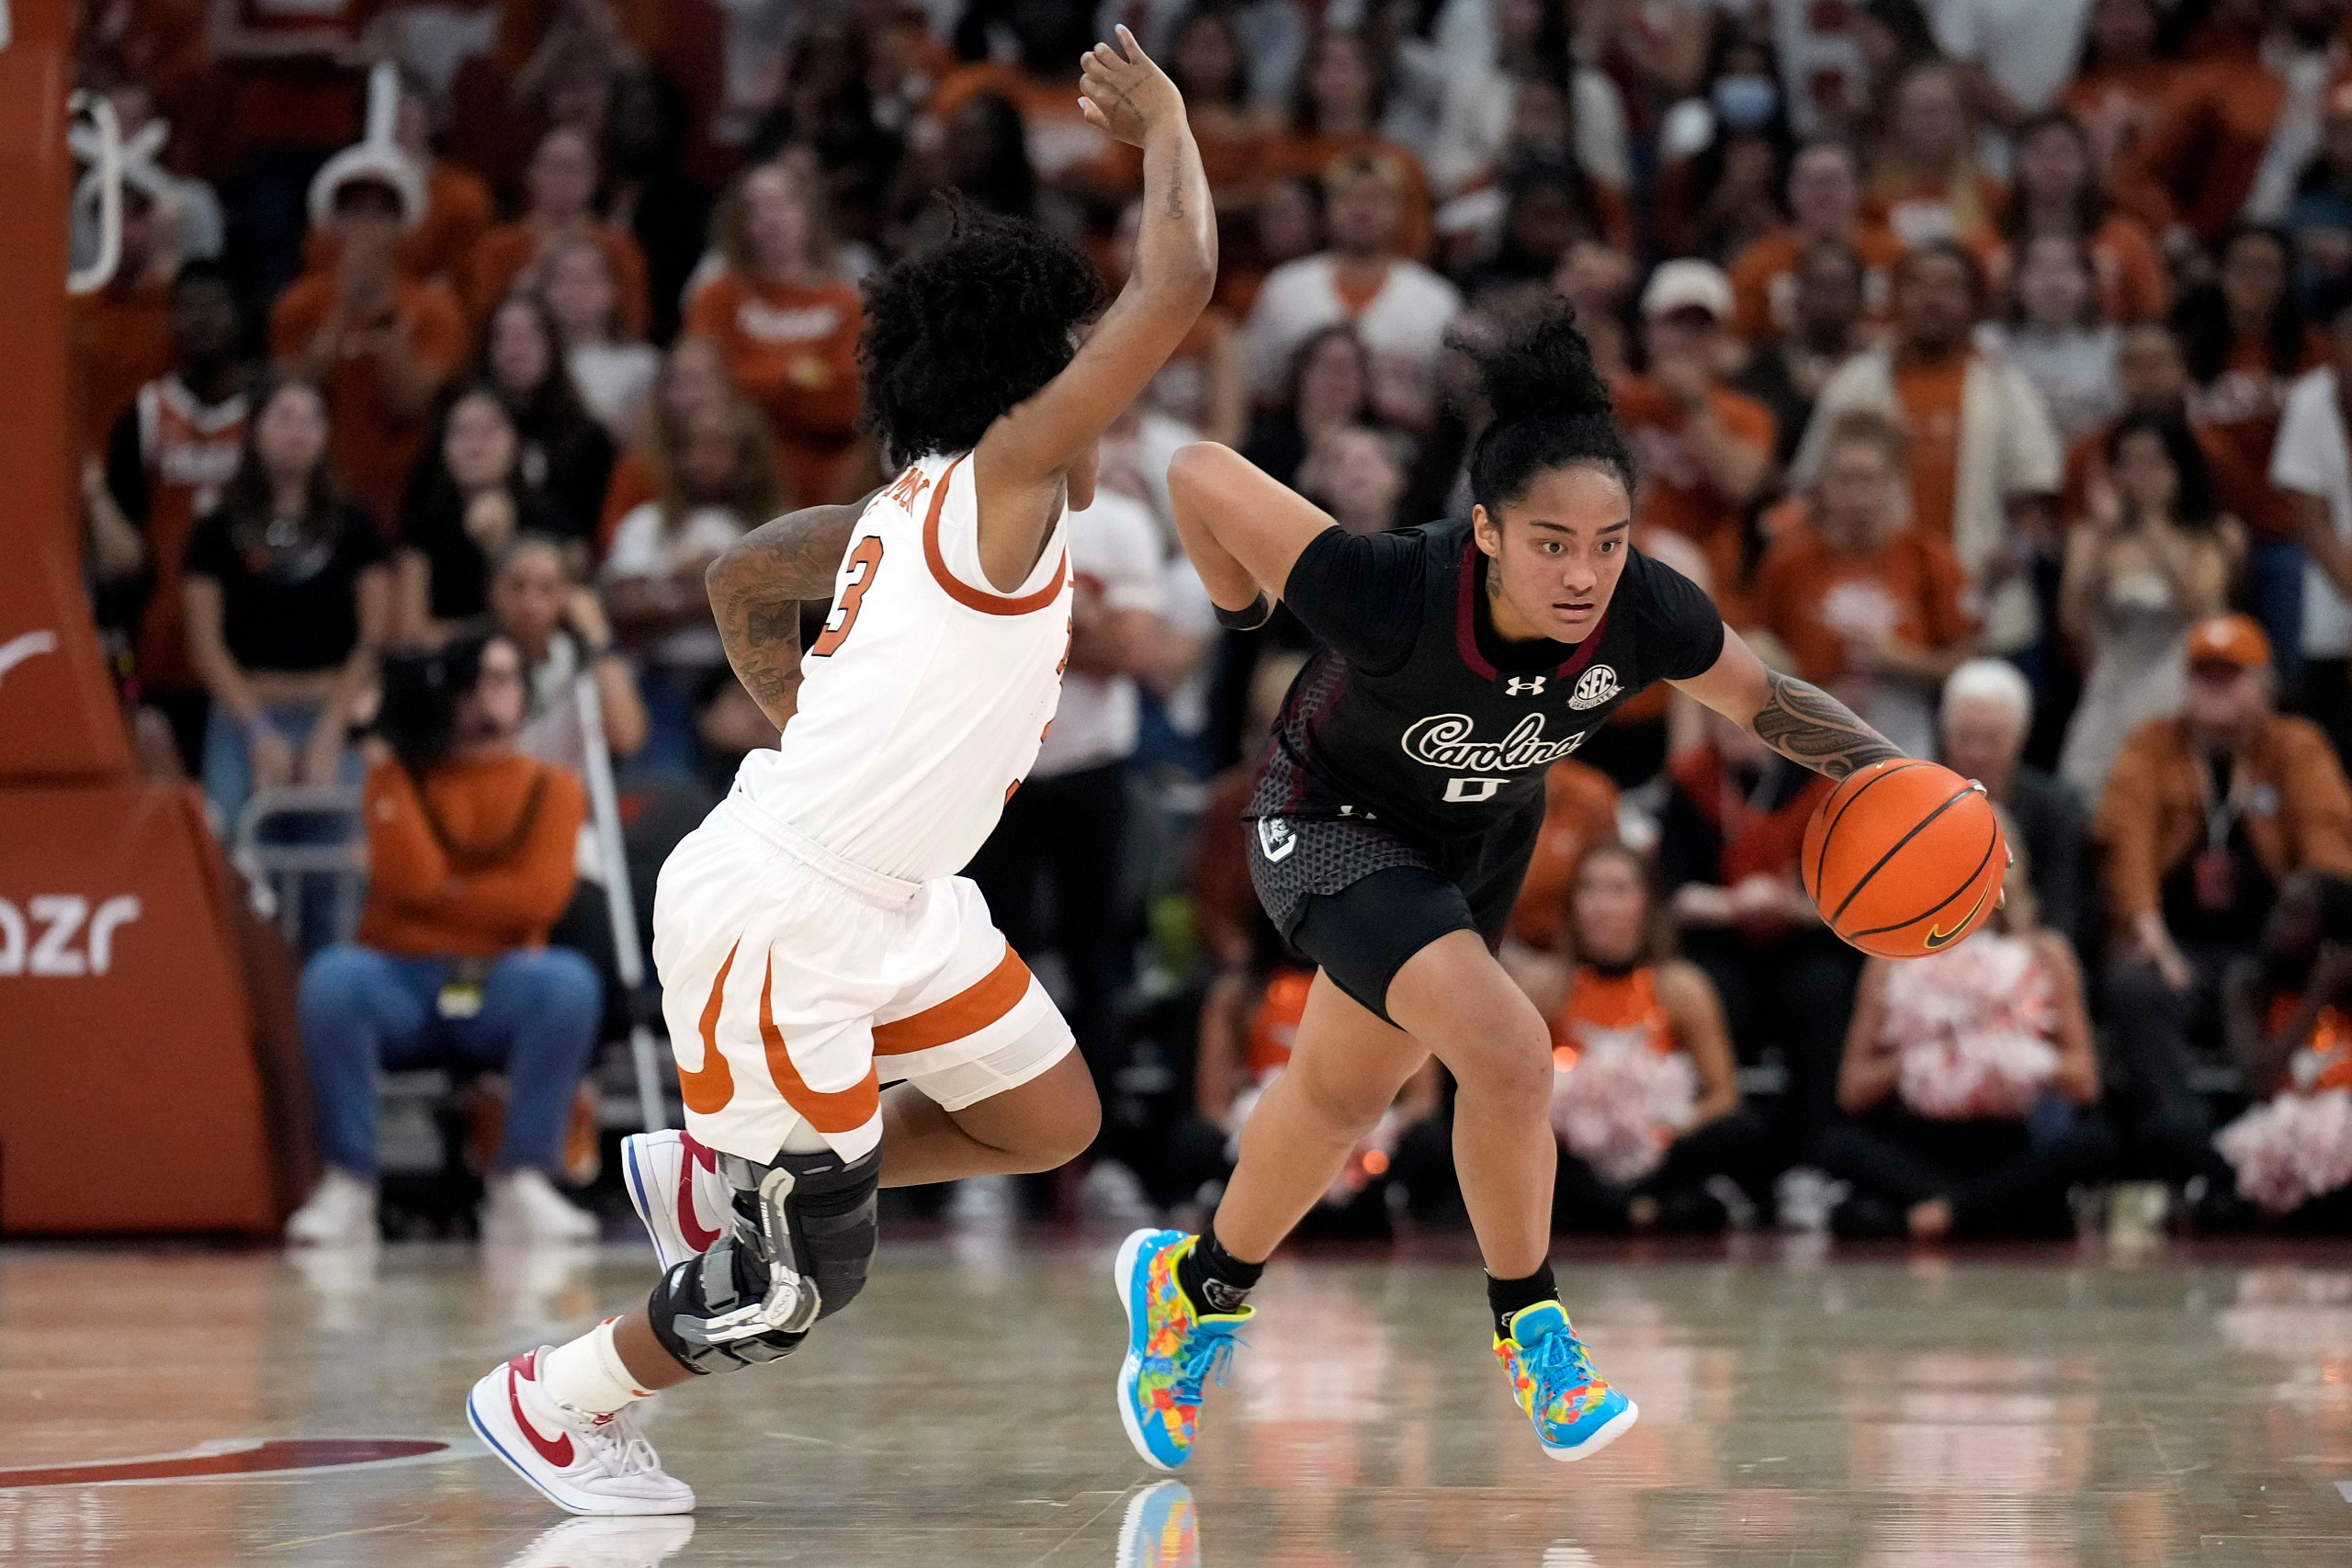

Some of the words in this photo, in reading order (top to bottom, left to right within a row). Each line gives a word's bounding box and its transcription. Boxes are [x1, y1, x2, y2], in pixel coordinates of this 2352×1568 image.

[811, 535, 884, 657] 3
[1571, 693, 1612, 709] GRADUATE
[1578, 668, 1613, 699] SEC
[1401, 713, 1586, 772] Carolina
